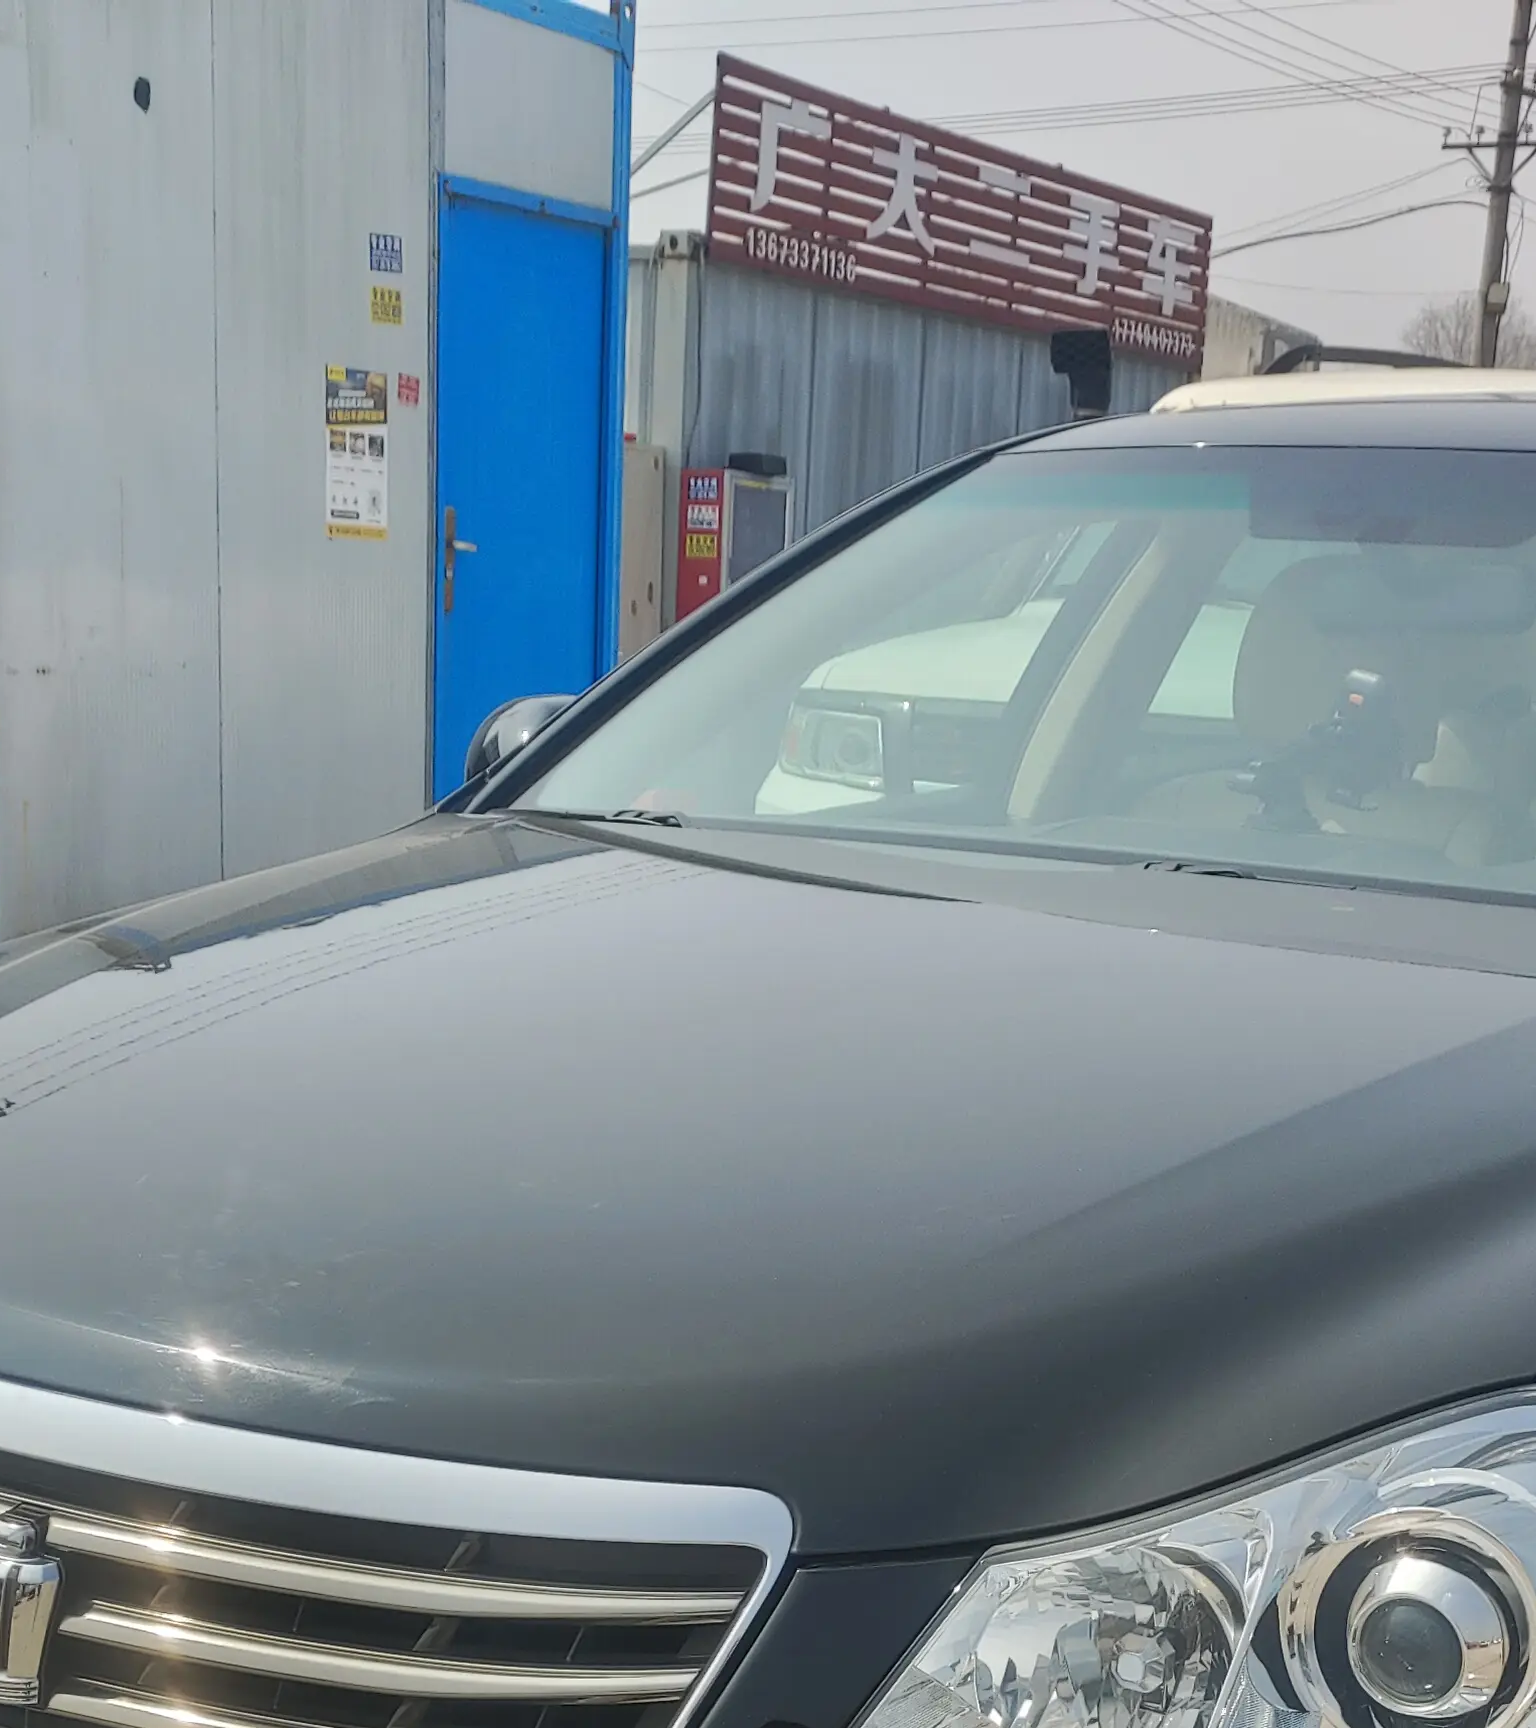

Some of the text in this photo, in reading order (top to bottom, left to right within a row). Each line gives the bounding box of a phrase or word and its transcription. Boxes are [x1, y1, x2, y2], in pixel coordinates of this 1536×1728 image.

[750, 98, 1199, 318] 广大二手车
